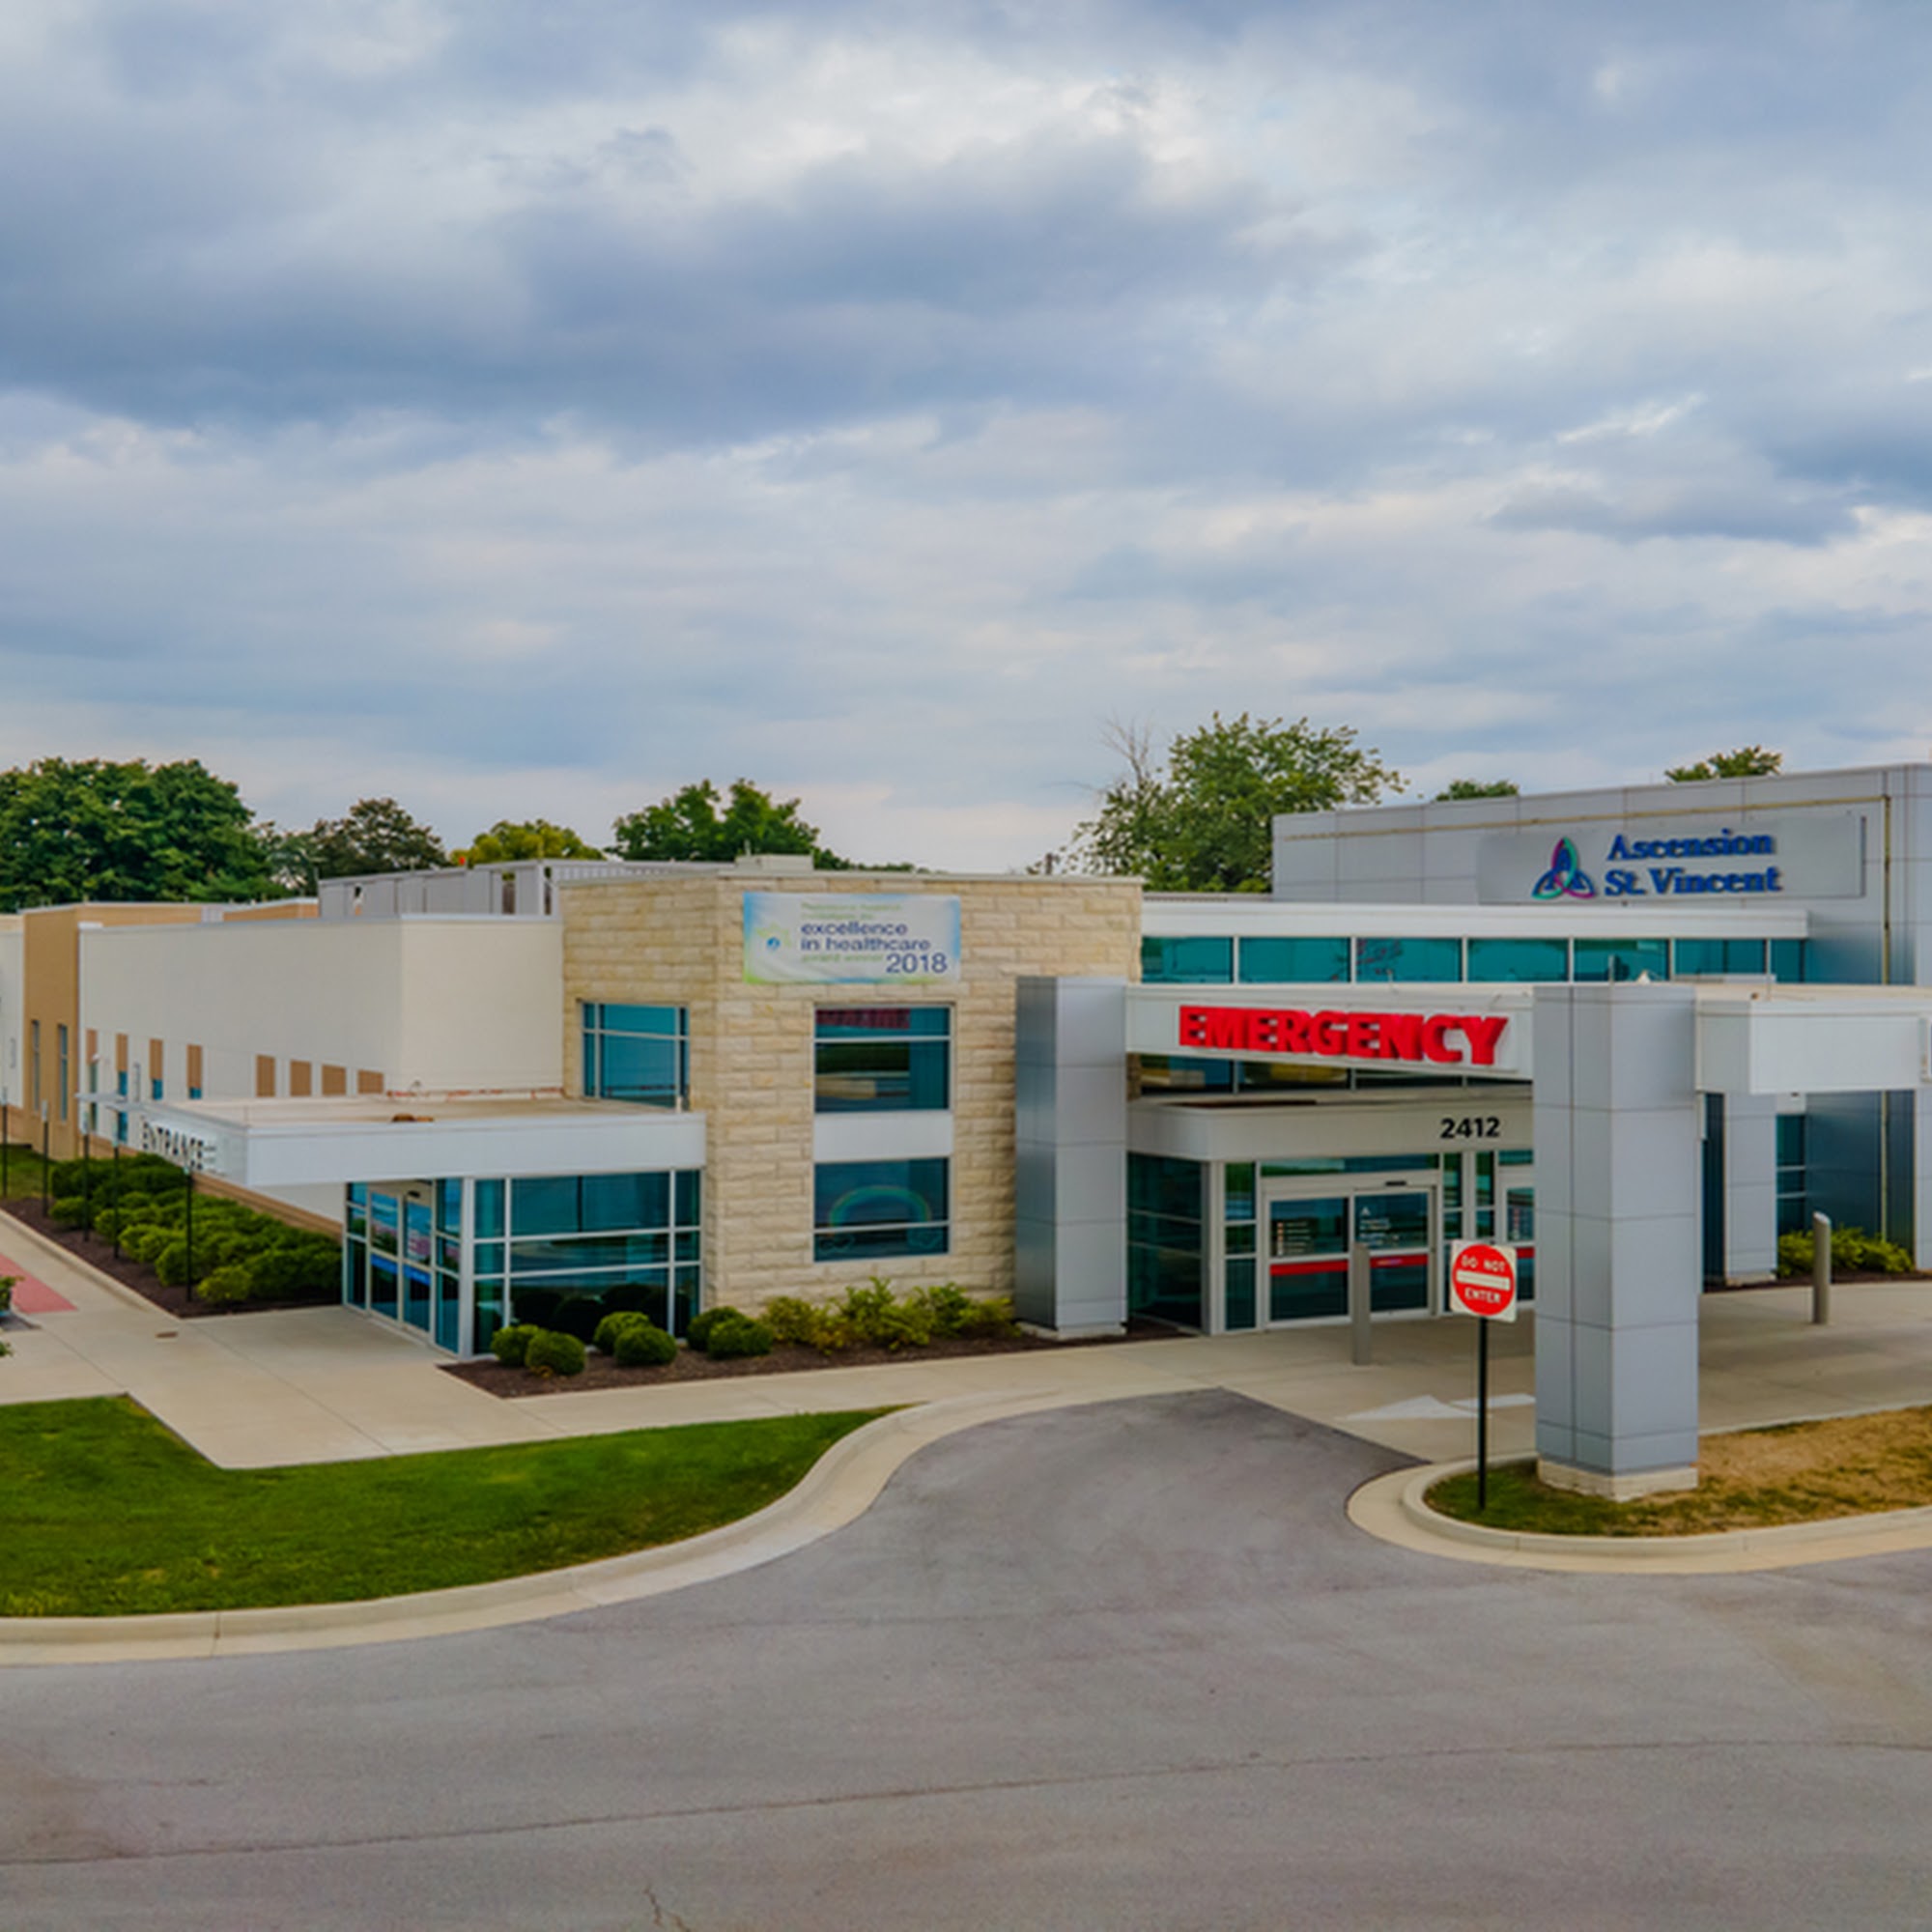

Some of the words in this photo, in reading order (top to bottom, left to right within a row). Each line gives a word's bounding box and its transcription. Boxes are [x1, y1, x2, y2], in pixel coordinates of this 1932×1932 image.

[1606, 828, 1776, 861] Ascension
[1605, 869, 1646, 896] St.
[1648, 867, 1782, 895] Vincent
[800, 921, 908, 935] excellence
[800, 937, 820, 951] in
[826, 937, 930, 952] healthcare
[886, 952, 948, 974] 2018
[1179, 1005, 1509, 1065] EMERGENCY
[1439, 1117, 1500, 1140] 2412
[142, 1122, 204, 1171] ENTRANCE
[1461, 1255, 1479, 1268] DO
[1483, 1259, 1505, 1272] NOT
[1465, 1288, 1500, 1303] ENTER
